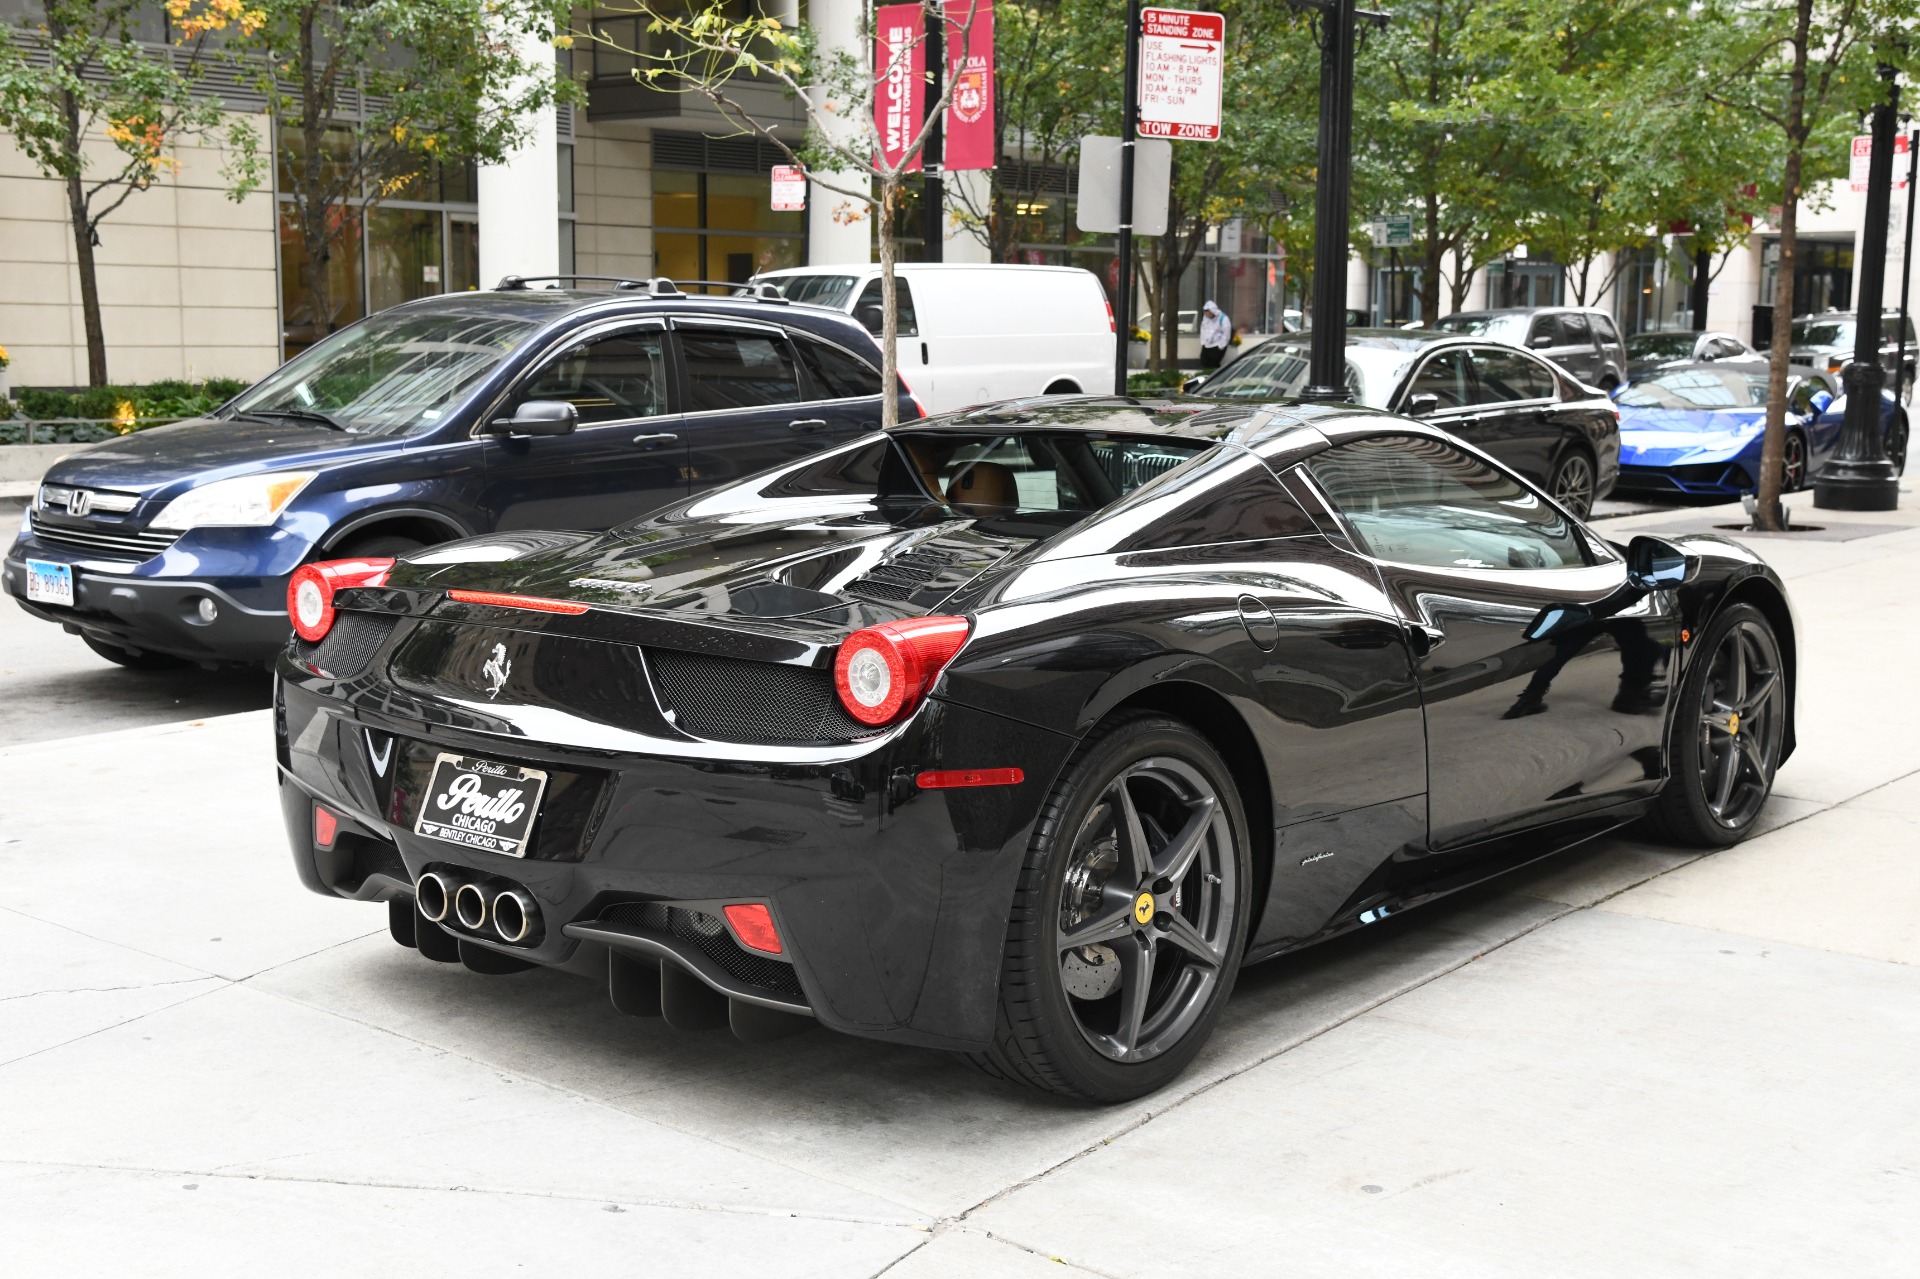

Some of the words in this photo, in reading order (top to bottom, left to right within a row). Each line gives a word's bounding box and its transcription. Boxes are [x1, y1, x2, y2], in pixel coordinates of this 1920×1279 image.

[1147, 13, 1157, 23] 15
[1158, 14, 1190, 26] MINUTE
[1147, 23, 1188, 36] STANDING
[1192, 27, 1215, 39] ZONE
[1146, 41, 1163, 50] USE
[1146, 52, 1187, 63] FLASHING
[1189, 56, 1217, 66] LIGHTS
[1146, 62, 1155, 71] 10
[1157, 63, 1170, 72] AM
[1178, 65, 1184, 73] 8
[1145, 73, 1164, 82] MON
[1174, 75, 1203, 86] THURS
[886, 27, 903, 153] WELCOME
[903, 75, 912, 114] TOWER
[1145, 83, 1153, 92] 10
[1155, 84, 1168, 93] AM
[1177, 86, 1183, 94] 6
[1185, 87, 1197, 95] PM
[1145, 93, 1159, 103] FRI
[1167, 95, 1185, 105] SUN
[902, 116, 911, 152] WATER
[1144, 121, 1172, 134] TOW
[1177, 124, 1213, 138] ZONE
[471, 760, 508, 776] Perillo
[437, 773, 526, 824] Perillo
[452, 813, 497, 834] CHICAGO
[439, 827, 466, 842] BENTLEY
[465, 833, 497, 849] CHICAGO
